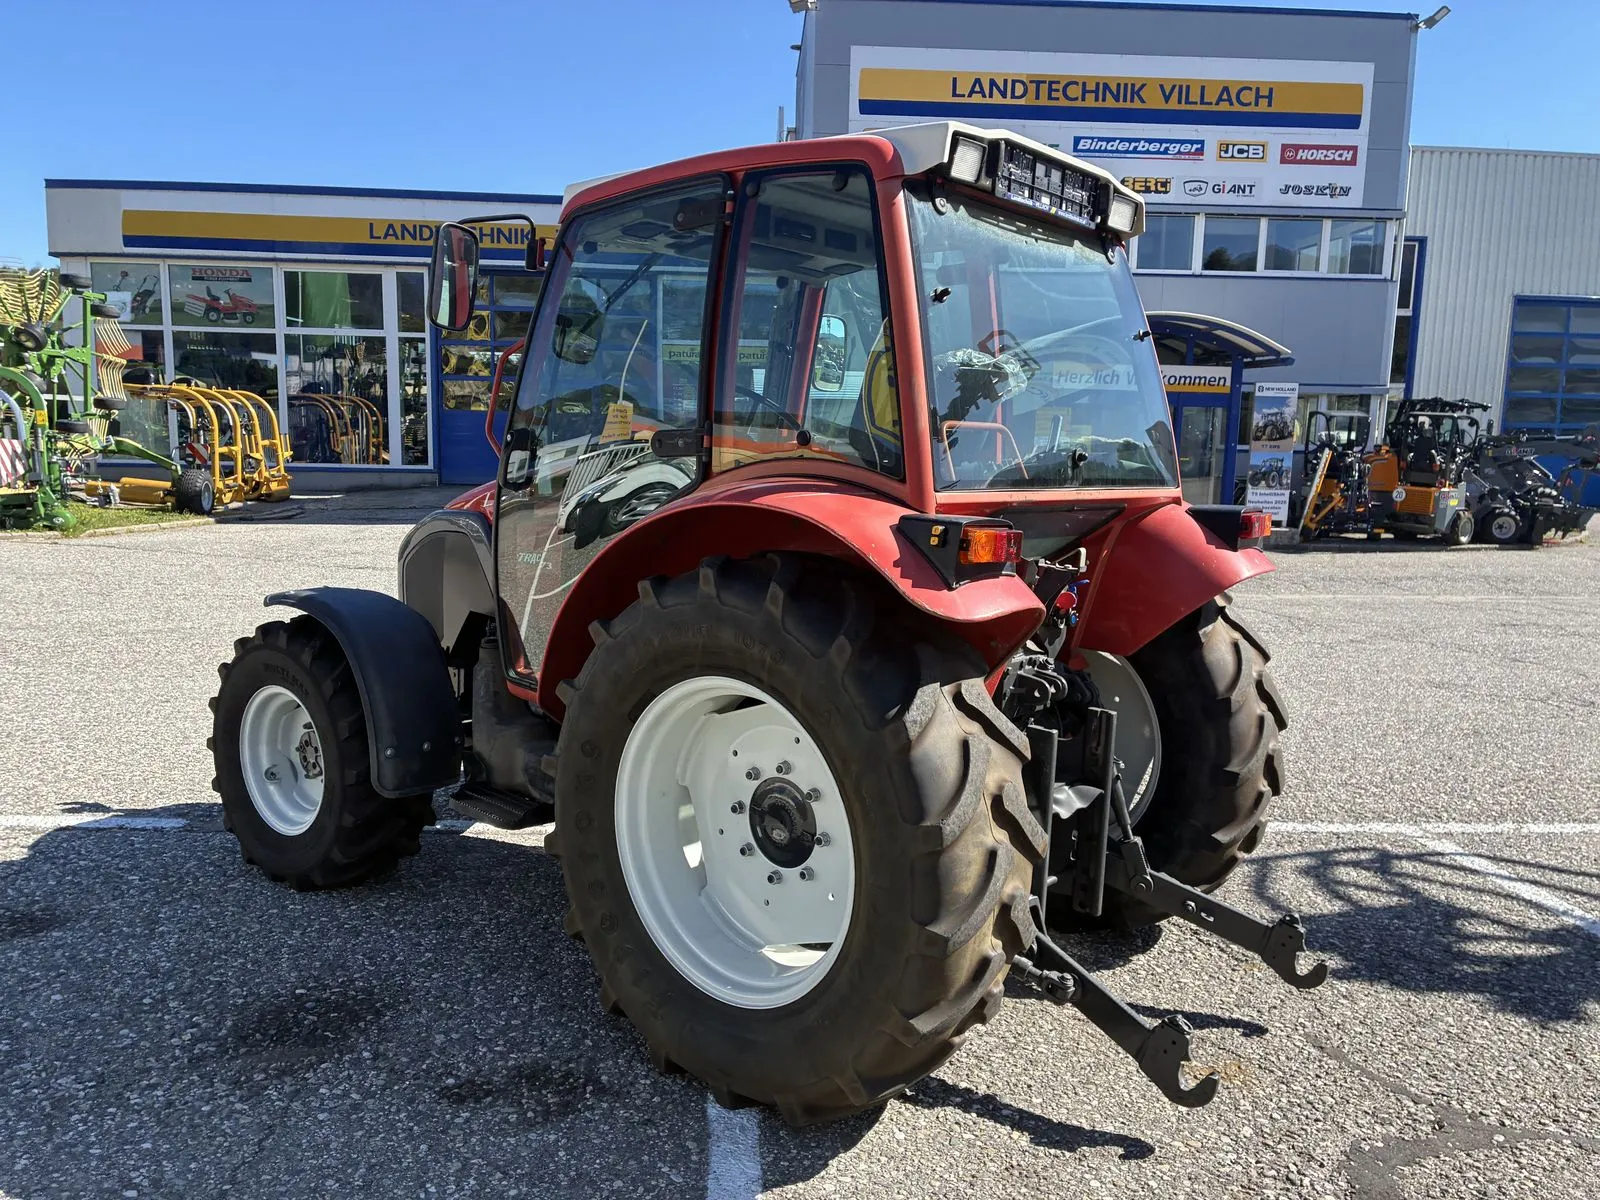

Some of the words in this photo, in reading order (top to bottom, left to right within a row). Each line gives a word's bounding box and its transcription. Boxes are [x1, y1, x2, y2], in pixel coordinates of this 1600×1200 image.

[951, 76, 1147, 104] LANDTECHNIK
[1159, 83, 1274, 107] VILLACH
[1077, 138, 1202, 154] Binderberger
[1220, 144, 1264, 158] JCB
[1296, 148, 1353, 161] HORSCH
[1279, 183, 1352, 198] JOSKIN
[191, 267, 252, 277] HONDA
[1057, 369, 1120, 385] Herzlich
